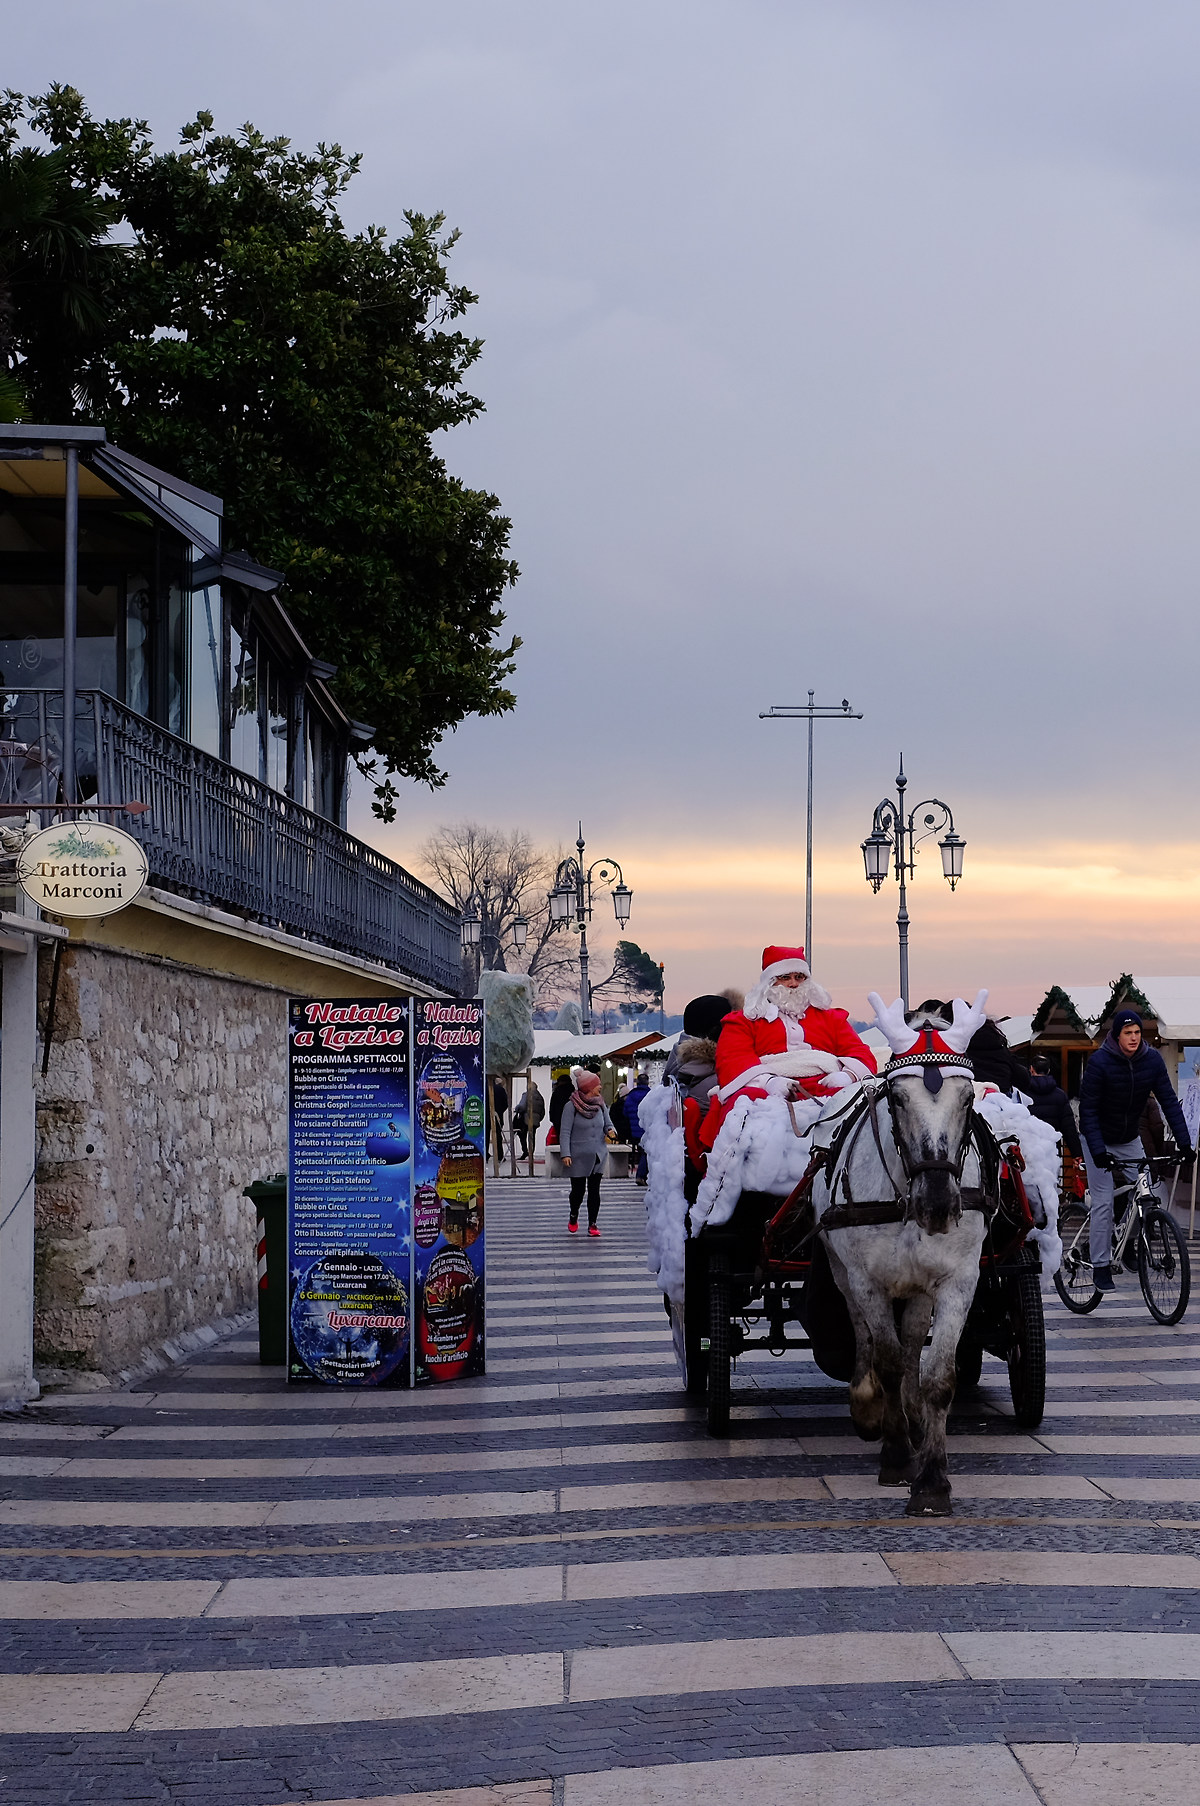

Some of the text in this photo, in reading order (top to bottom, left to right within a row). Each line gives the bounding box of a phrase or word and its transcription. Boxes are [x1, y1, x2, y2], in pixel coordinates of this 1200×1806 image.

[38, 862, 127, 878] Trattoria
[42, 883, 123, 898] Marconi
[305, 1003, 401, 1023] Natale
[424, 1002, 479, 1023] Natale
[294, 1025, 404, 1051] a Lazise
[417, 1025, 481, 1051] a Lazise
[293, 1054, 406, 1064] PROGRAMMA SPETTACOLI
[327, 1101, 350, 1110] Gospel
[345, 1139, 366, 1147] pazzie
[294, 1158, 333, 1166] Spettacolari
[324, 1176, 331, 1184] di
[345, 1176, 370, 1184] Stefano
[324, 1249, 364, 1257] dell'Epifania
[317, 1263, 322, 1271] 7
[324, 1263, 357, 1271] Gennaio
[300, 1291, 305, 1300] 6
[306, 1291, 340, 1300] Gennaio
[327, 1310, 406, 1332] Luxarcana
[434, 1334, 453, 1342] dicembre
[425, 1351, 468, 1363] fuochi d'artificio
[321, 1358, 380, 1368] Spettacolari magie
